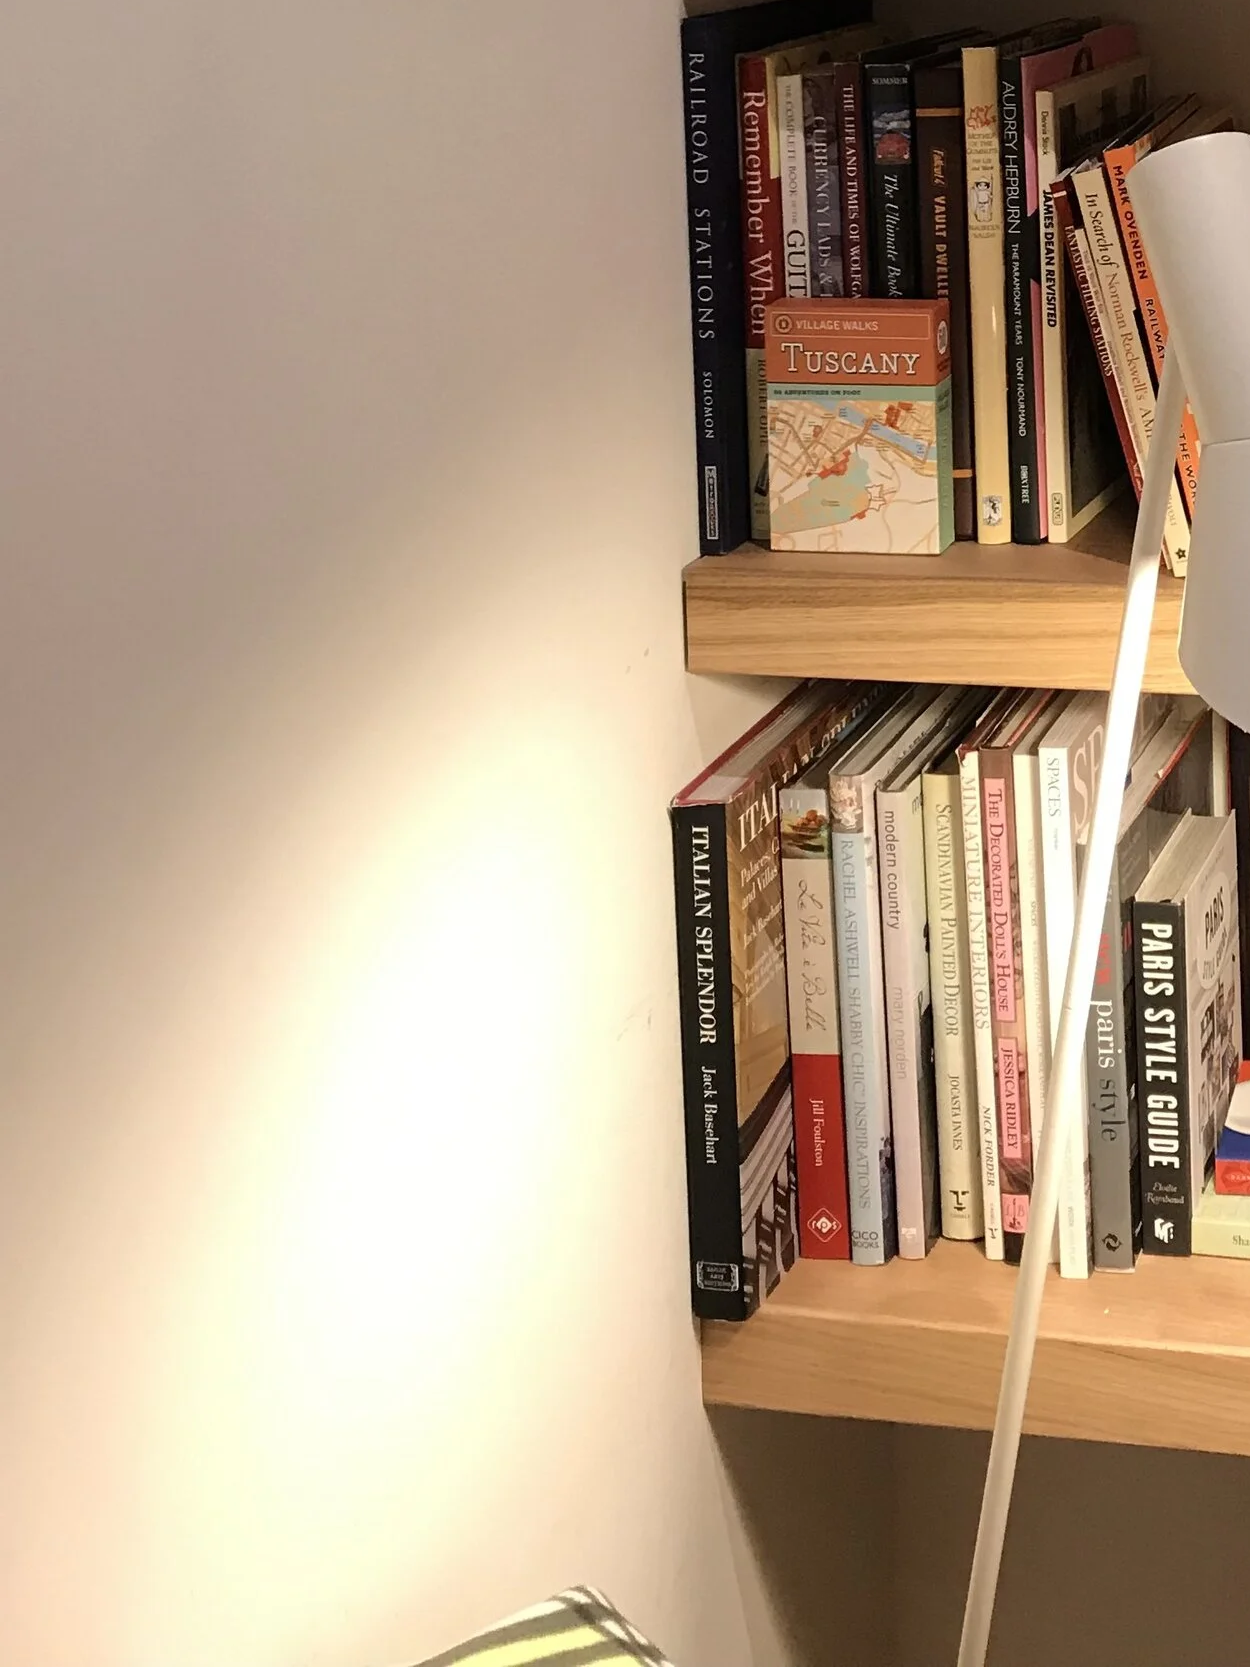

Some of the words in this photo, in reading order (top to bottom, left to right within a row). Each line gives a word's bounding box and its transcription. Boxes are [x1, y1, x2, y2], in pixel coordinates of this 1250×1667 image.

[687, 52, 711, 185] RAILROAD
[1001, 80, 1021, 152] AUDREY
[741, 90, 770, 243] Remember
[1004, 154, 1022, 234] HEPBURN
[1042, 189, 1056, 227] JAMES
[694, 208, 715, 340] STATIONS
[1043, 230, 1056, 265] DEAN
[750, 250, 773, 335] When
[795, 320, 841, 330] VILLAGE
[845, 320, 880, 330] WALKS
[1045, 268, 1058, 328] REVISITED
[703, 371, 715, 440] SOLOMON
[691, 825, 713, 920] ITALIAN
[694, 925, 717, 1044] SPLENDOR
[1142, 922, 1173, 995] PARIS
[702, 1066, 719, 1096] Jack
[1146, 1008, 1176, 1082] STYLE
[703, 1100, 720, 1165] Basehart
[811, 1098, 826, 1115] Jill
[812, 1118, 827, 1167] Foulston
[1147, 1094, 1180, 1169] GUIDE
